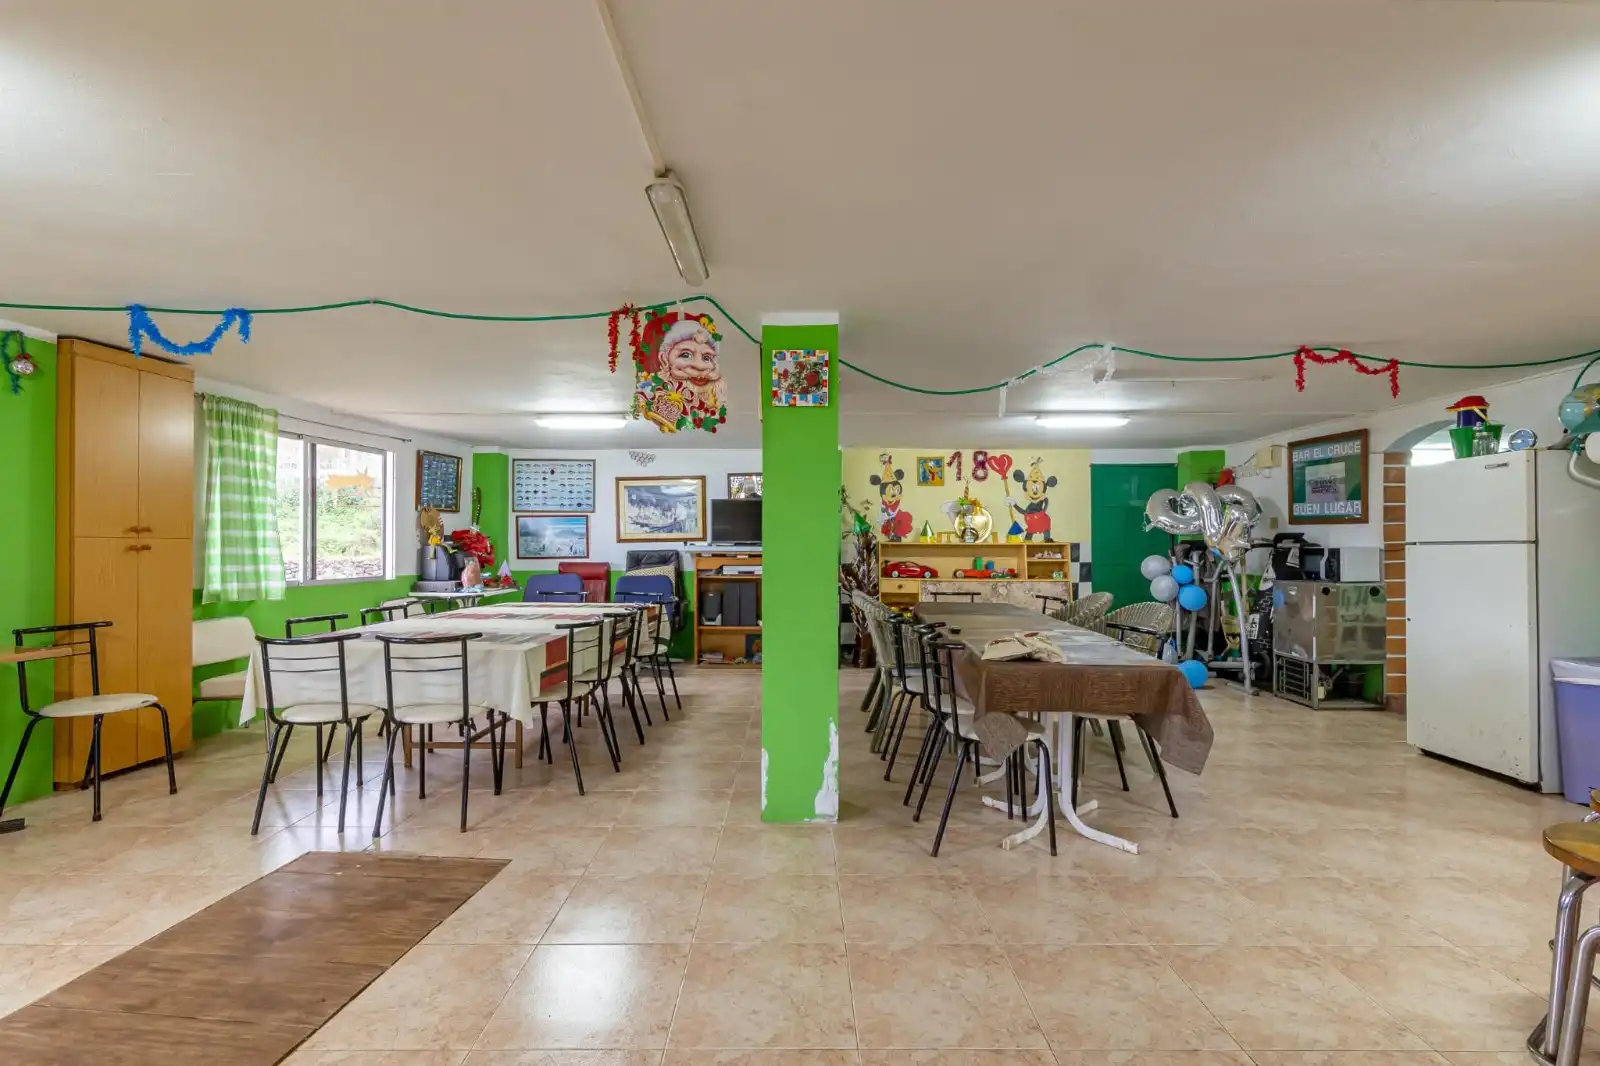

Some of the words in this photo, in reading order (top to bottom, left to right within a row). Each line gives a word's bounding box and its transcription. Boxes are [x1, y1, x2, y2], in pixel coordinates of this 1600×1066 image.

[1292, 450, 1310, 462] BAR
[1313, 448, 1325, 458] EL
[1327, 440, 1361, 457] CRUCE
[946, 450, 988, 482] 18
[1293, 503, 1320, 516] BUEN
[1324, 500, 1362, 515] LUGAR
